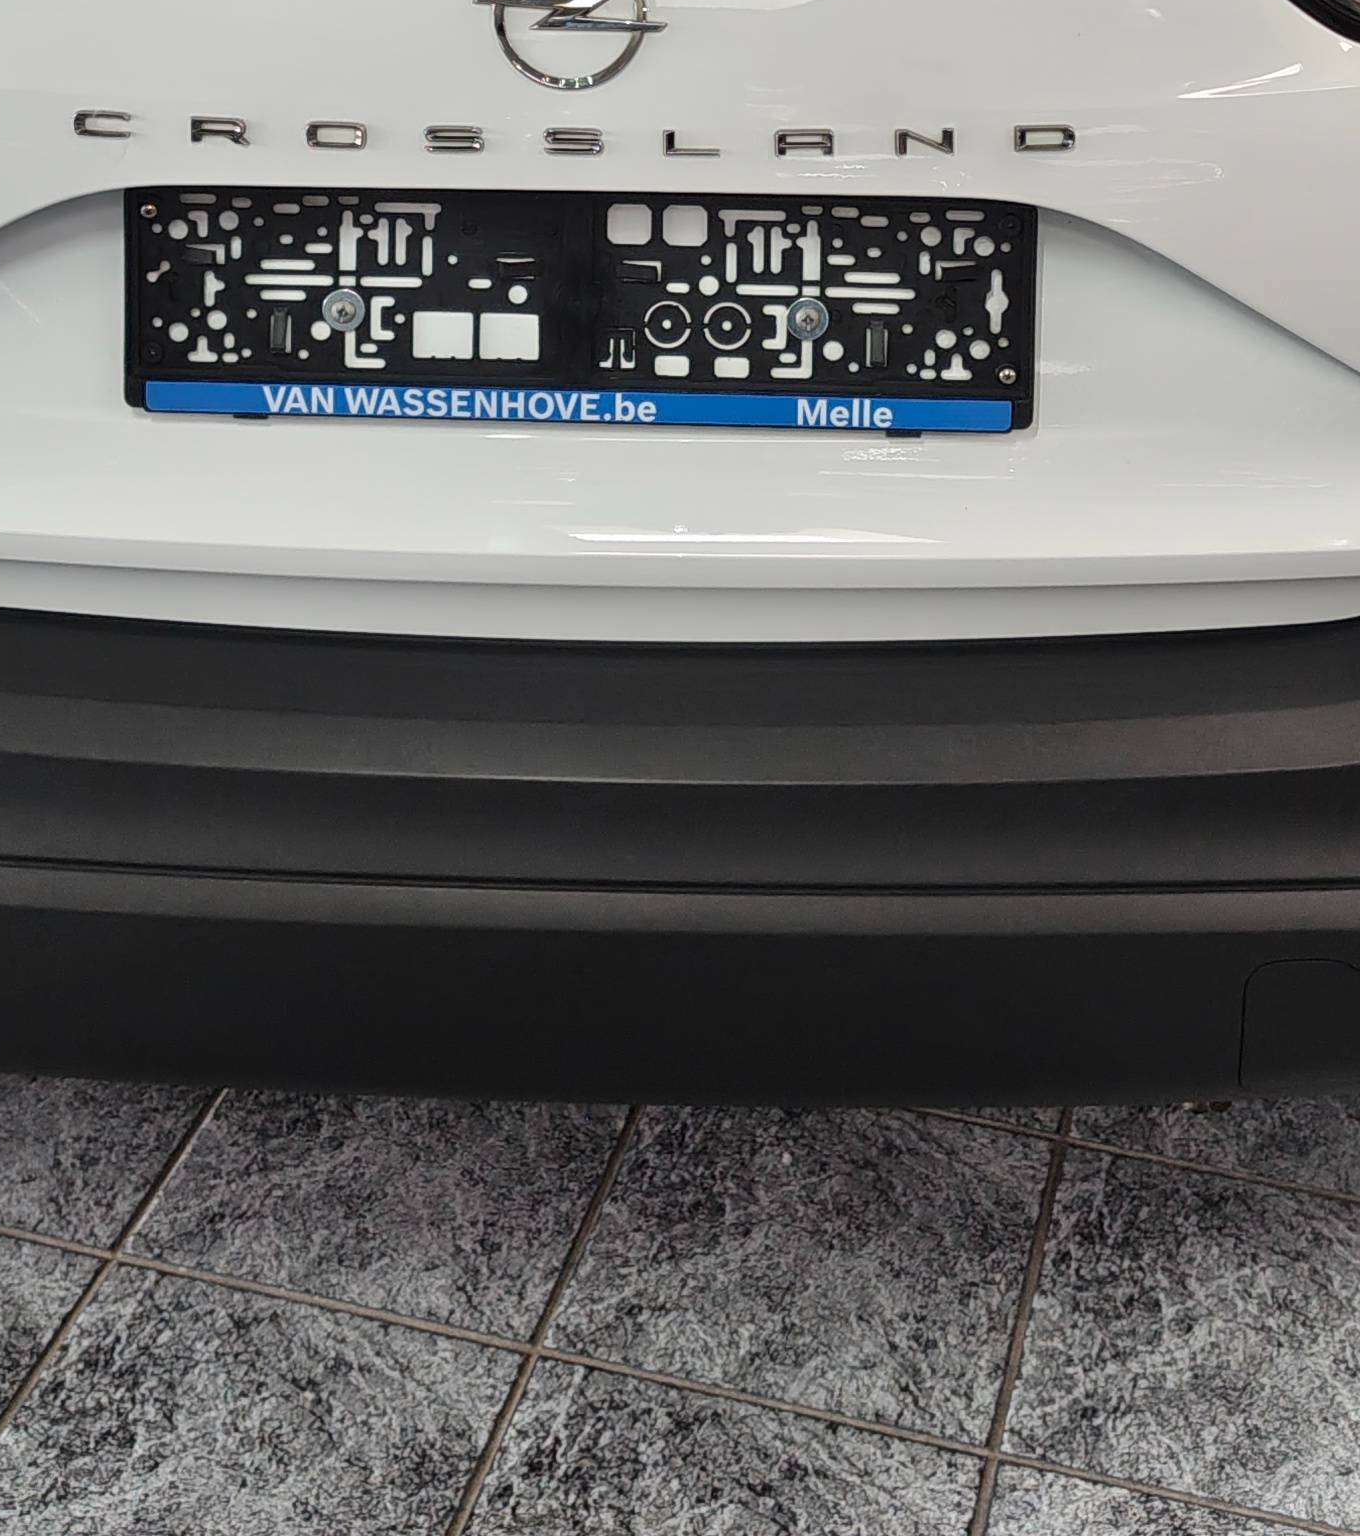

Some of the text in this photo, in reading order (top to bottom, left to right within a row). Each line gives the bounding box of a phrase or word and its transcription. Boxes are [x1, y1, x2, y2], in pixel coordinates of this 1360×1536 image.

[72, 108, 1077, 158] CROSSLAND
[261, 385, 894, 429] VAN WASSENHOVE.be Melle
